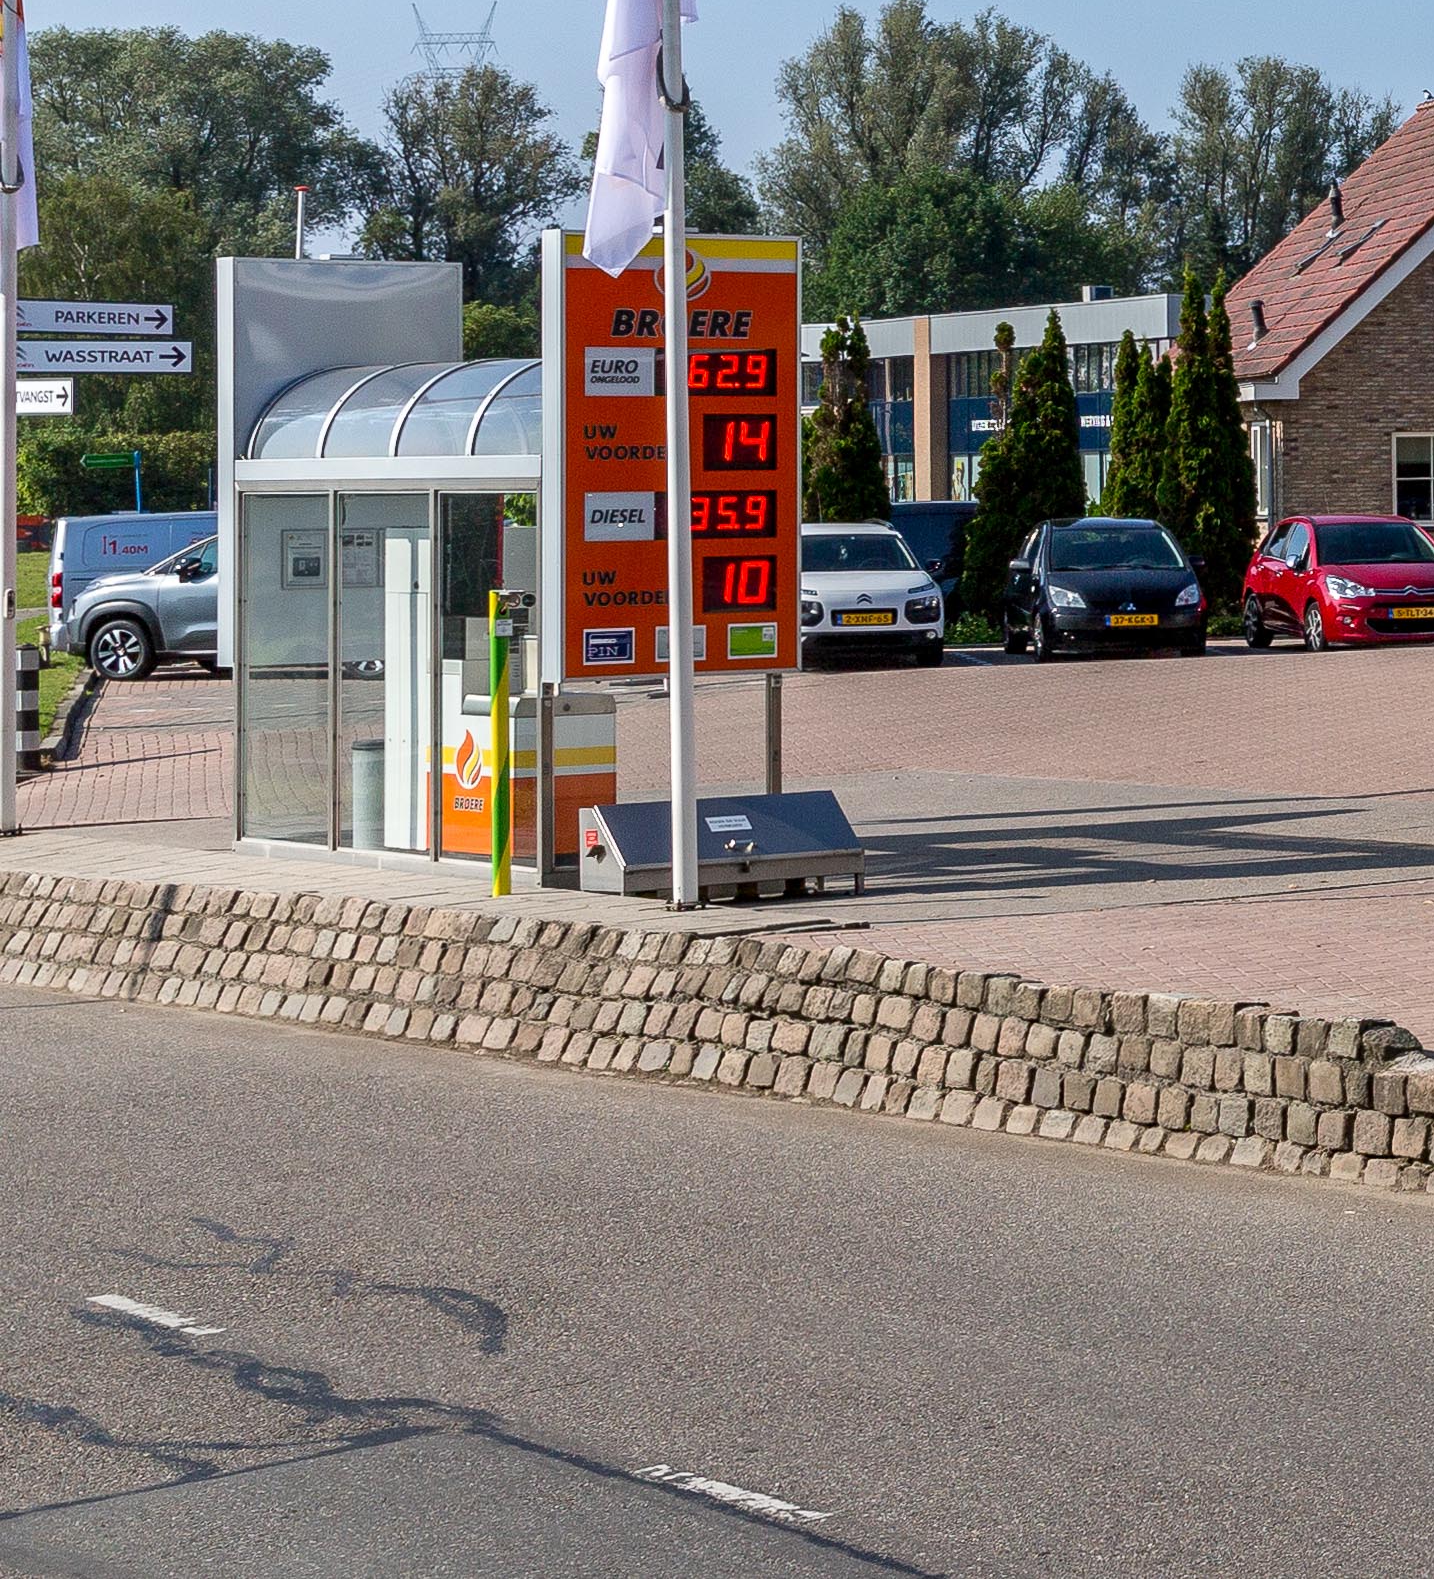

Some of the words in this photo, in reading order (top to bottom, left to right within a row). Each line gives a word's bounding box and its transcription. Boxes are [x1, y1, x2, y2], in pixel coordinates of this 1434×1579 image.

[54, 310, 140, 325] PARKEREN
[610, 307, 753, 340] BRERE
[44, 349, 154, 364] WASSTRAAT
[590, 359, 639, 374] EURO
[590, 375, 640, 384] ONGELOOD
[583, 424, 618, 440] UW
[723, 421, 770, 462] 14
[585, 445, 667, 461] VOORDE
[590, 508, 646, 524] DIESEL
[582, 571, 617, 586] UW
[723, 560, 770, 605] 10
[583, 589, 668, 607] VOORDE
[587, 646, 619, 657] PIN
[454, 796, 484, 812] BROERE
